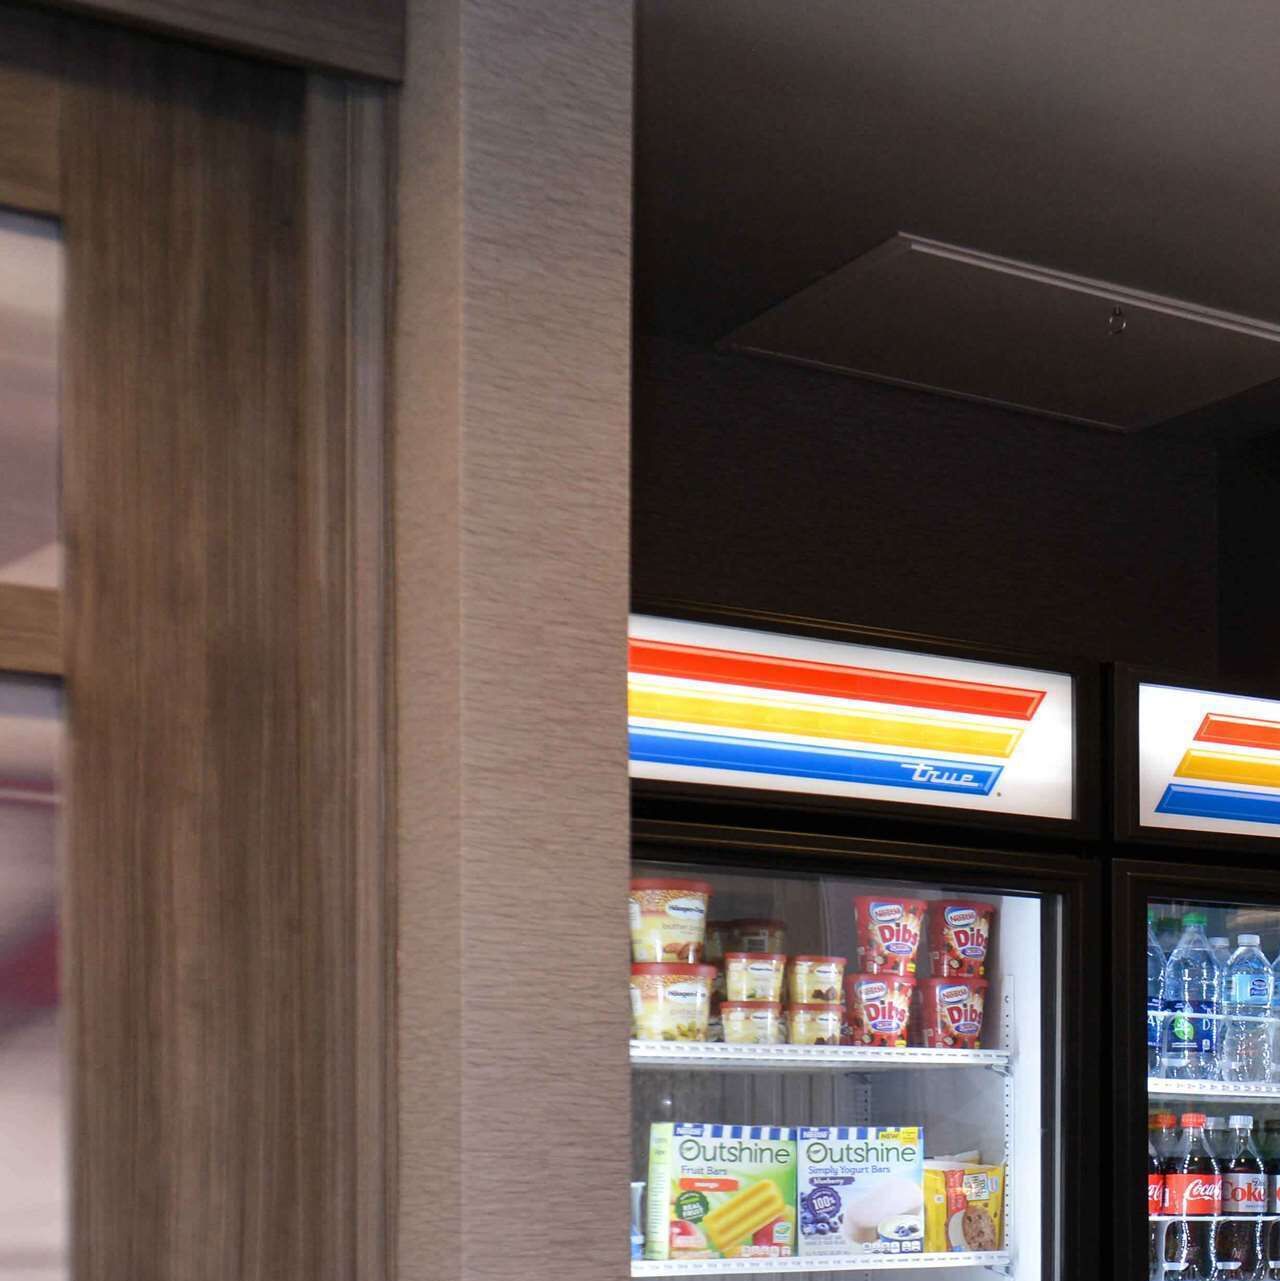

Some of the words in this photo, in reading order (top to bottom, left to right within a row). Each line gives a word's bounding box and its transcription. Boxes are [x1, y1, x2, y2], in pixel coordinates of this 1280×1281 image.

[901, 762, 982, 788] true
[878, 922, 918, 946] Dibs
[679, 1139, 791, 1165] Outshine
[807, 1141, 916, 1165] Outshine
[808, 1165, 839, 1177] Simply
[841, 1165, 870, 1177] Yogurt
